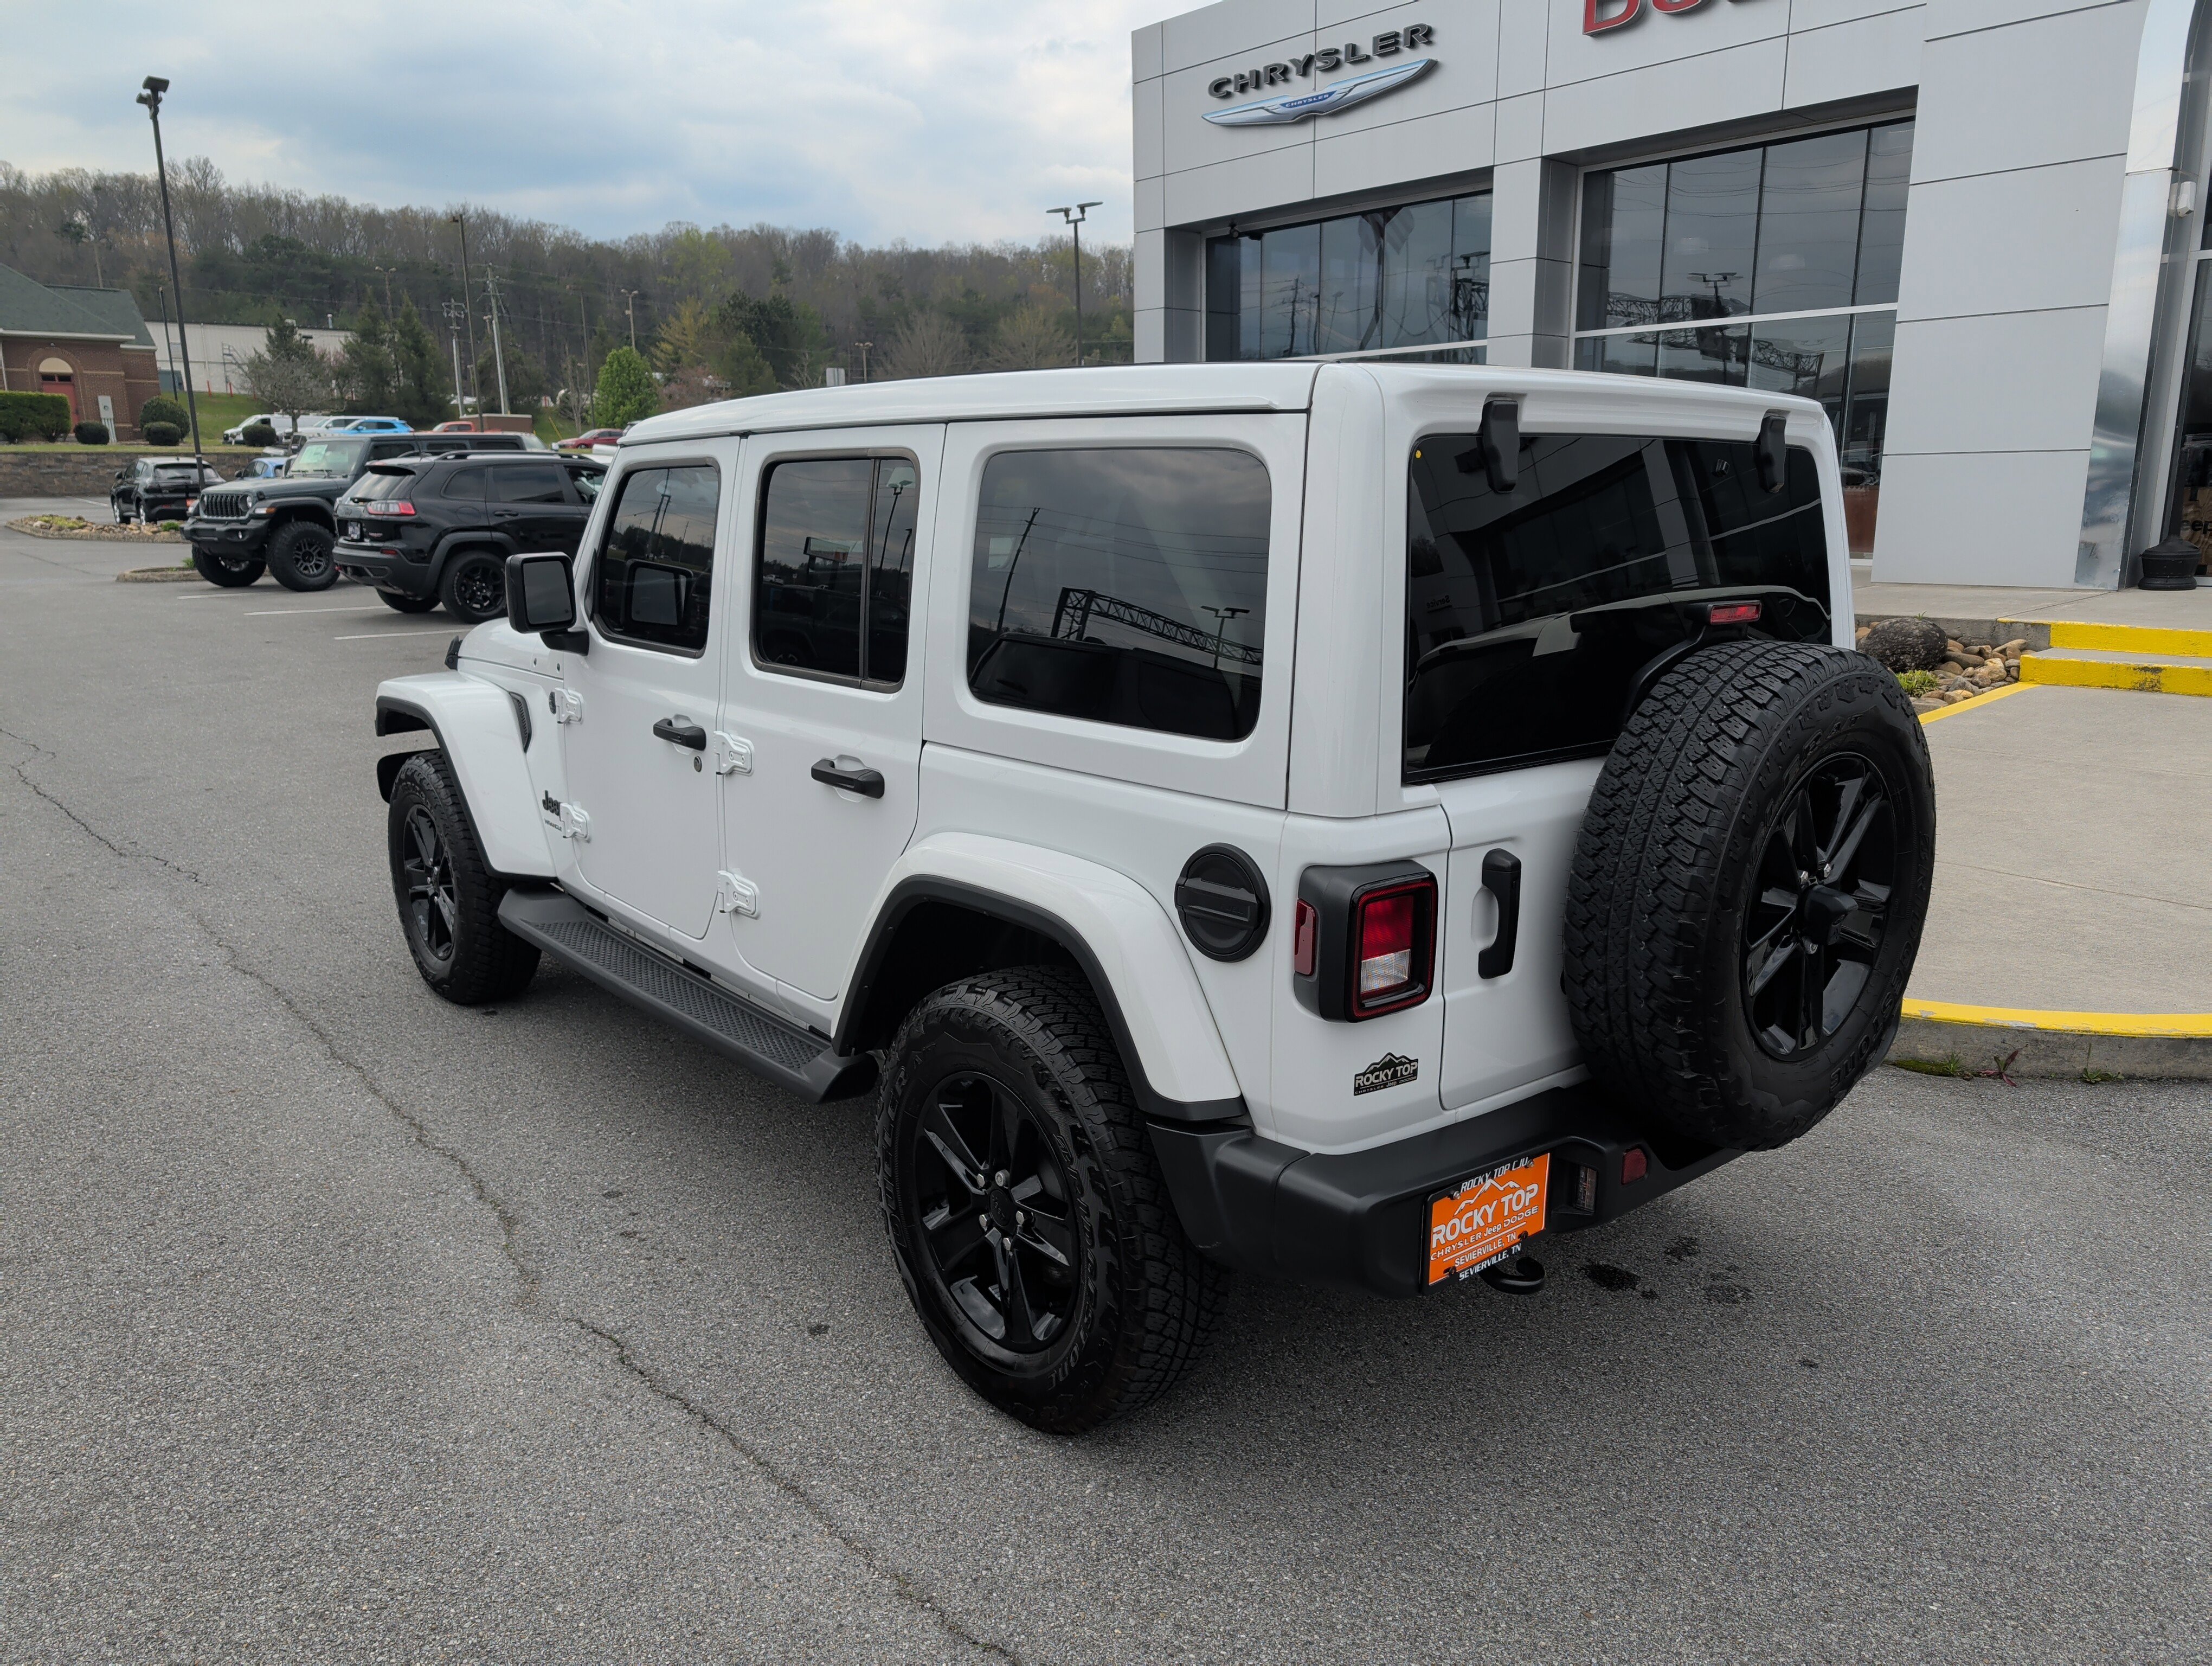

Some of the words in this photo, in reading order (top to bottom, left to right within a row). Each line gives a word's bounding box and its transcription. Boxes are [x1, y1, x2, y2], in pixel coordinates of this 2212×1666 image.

[1208, 23, 1433, 99] CHRYSLER
[1285, 94, 1329, 107] CHRYSLER
[2181, 520, 2212, 535] eep
[542, 790, 561, 816] Jee
[1830, 831, 1931, 1088] BRIDGESTONE
[1355, 1068, 1394, 1087] ROCKY
[1396, 1062, 1418, 1077] TOP
[1460, 1171, 1491, 1193] ROCKY
[1494, 1163, 1510, 1179] TOP
[1432, 1200, 1498, 1248] ROCKY
[1501, 1183, 1539, 1216] TOP
[1430, 1232, 1482, 1261] CHRYSLER
[1484, 1223, 1501, 1236] Jeep
[1503, 1206, 1539, 1228] DODGE
[1455, 1239, 1504, 1267] SEVIERVILLE,
[1507, 1231, 1516, 1244] TN
[1511, 1243, 1522, 1254] TN
[1047, 1132, 1097, 1392] BRIDGESTONE
